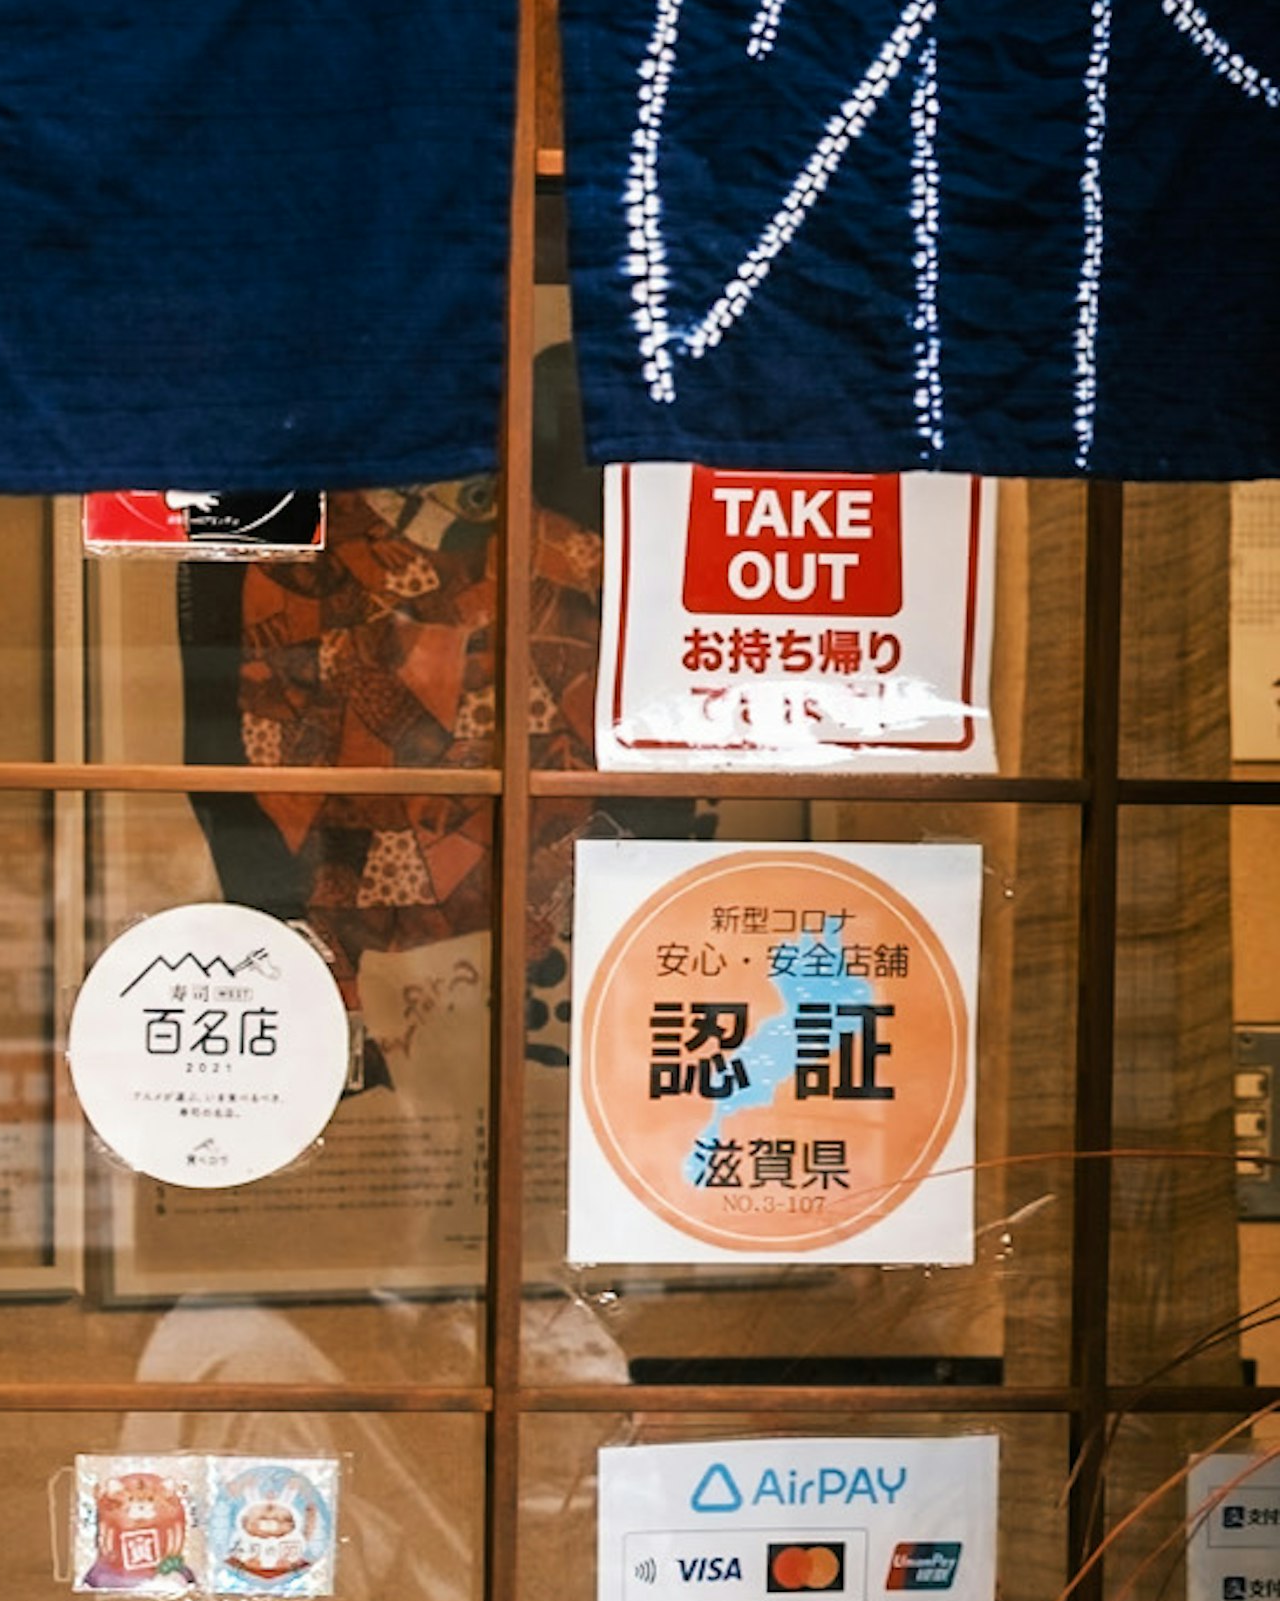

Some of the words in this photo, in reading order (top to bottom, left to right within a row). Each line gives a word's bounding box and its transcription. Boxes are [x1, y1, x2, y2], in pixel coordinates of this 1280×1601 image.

[713, 487, 873, 539] TAKE
[727, 550, 860, 602] OUT
[680, 628, 902, 674] お持ち帰り
[710, 906, 857, 935] 新型コロナ
[655, 943, 910, 979] 安心・安全店舗
[142, 1006, 279, 1056] 百名店
[648, 1002, 895, 1100] 認証
[185, 1062, 233, 1073] 2021
[692, 1137, 851, 1190] 滋賀県
[752, 1467, 907, 1505] AirPAY
[676, 1556, 743, 1583] VISA
